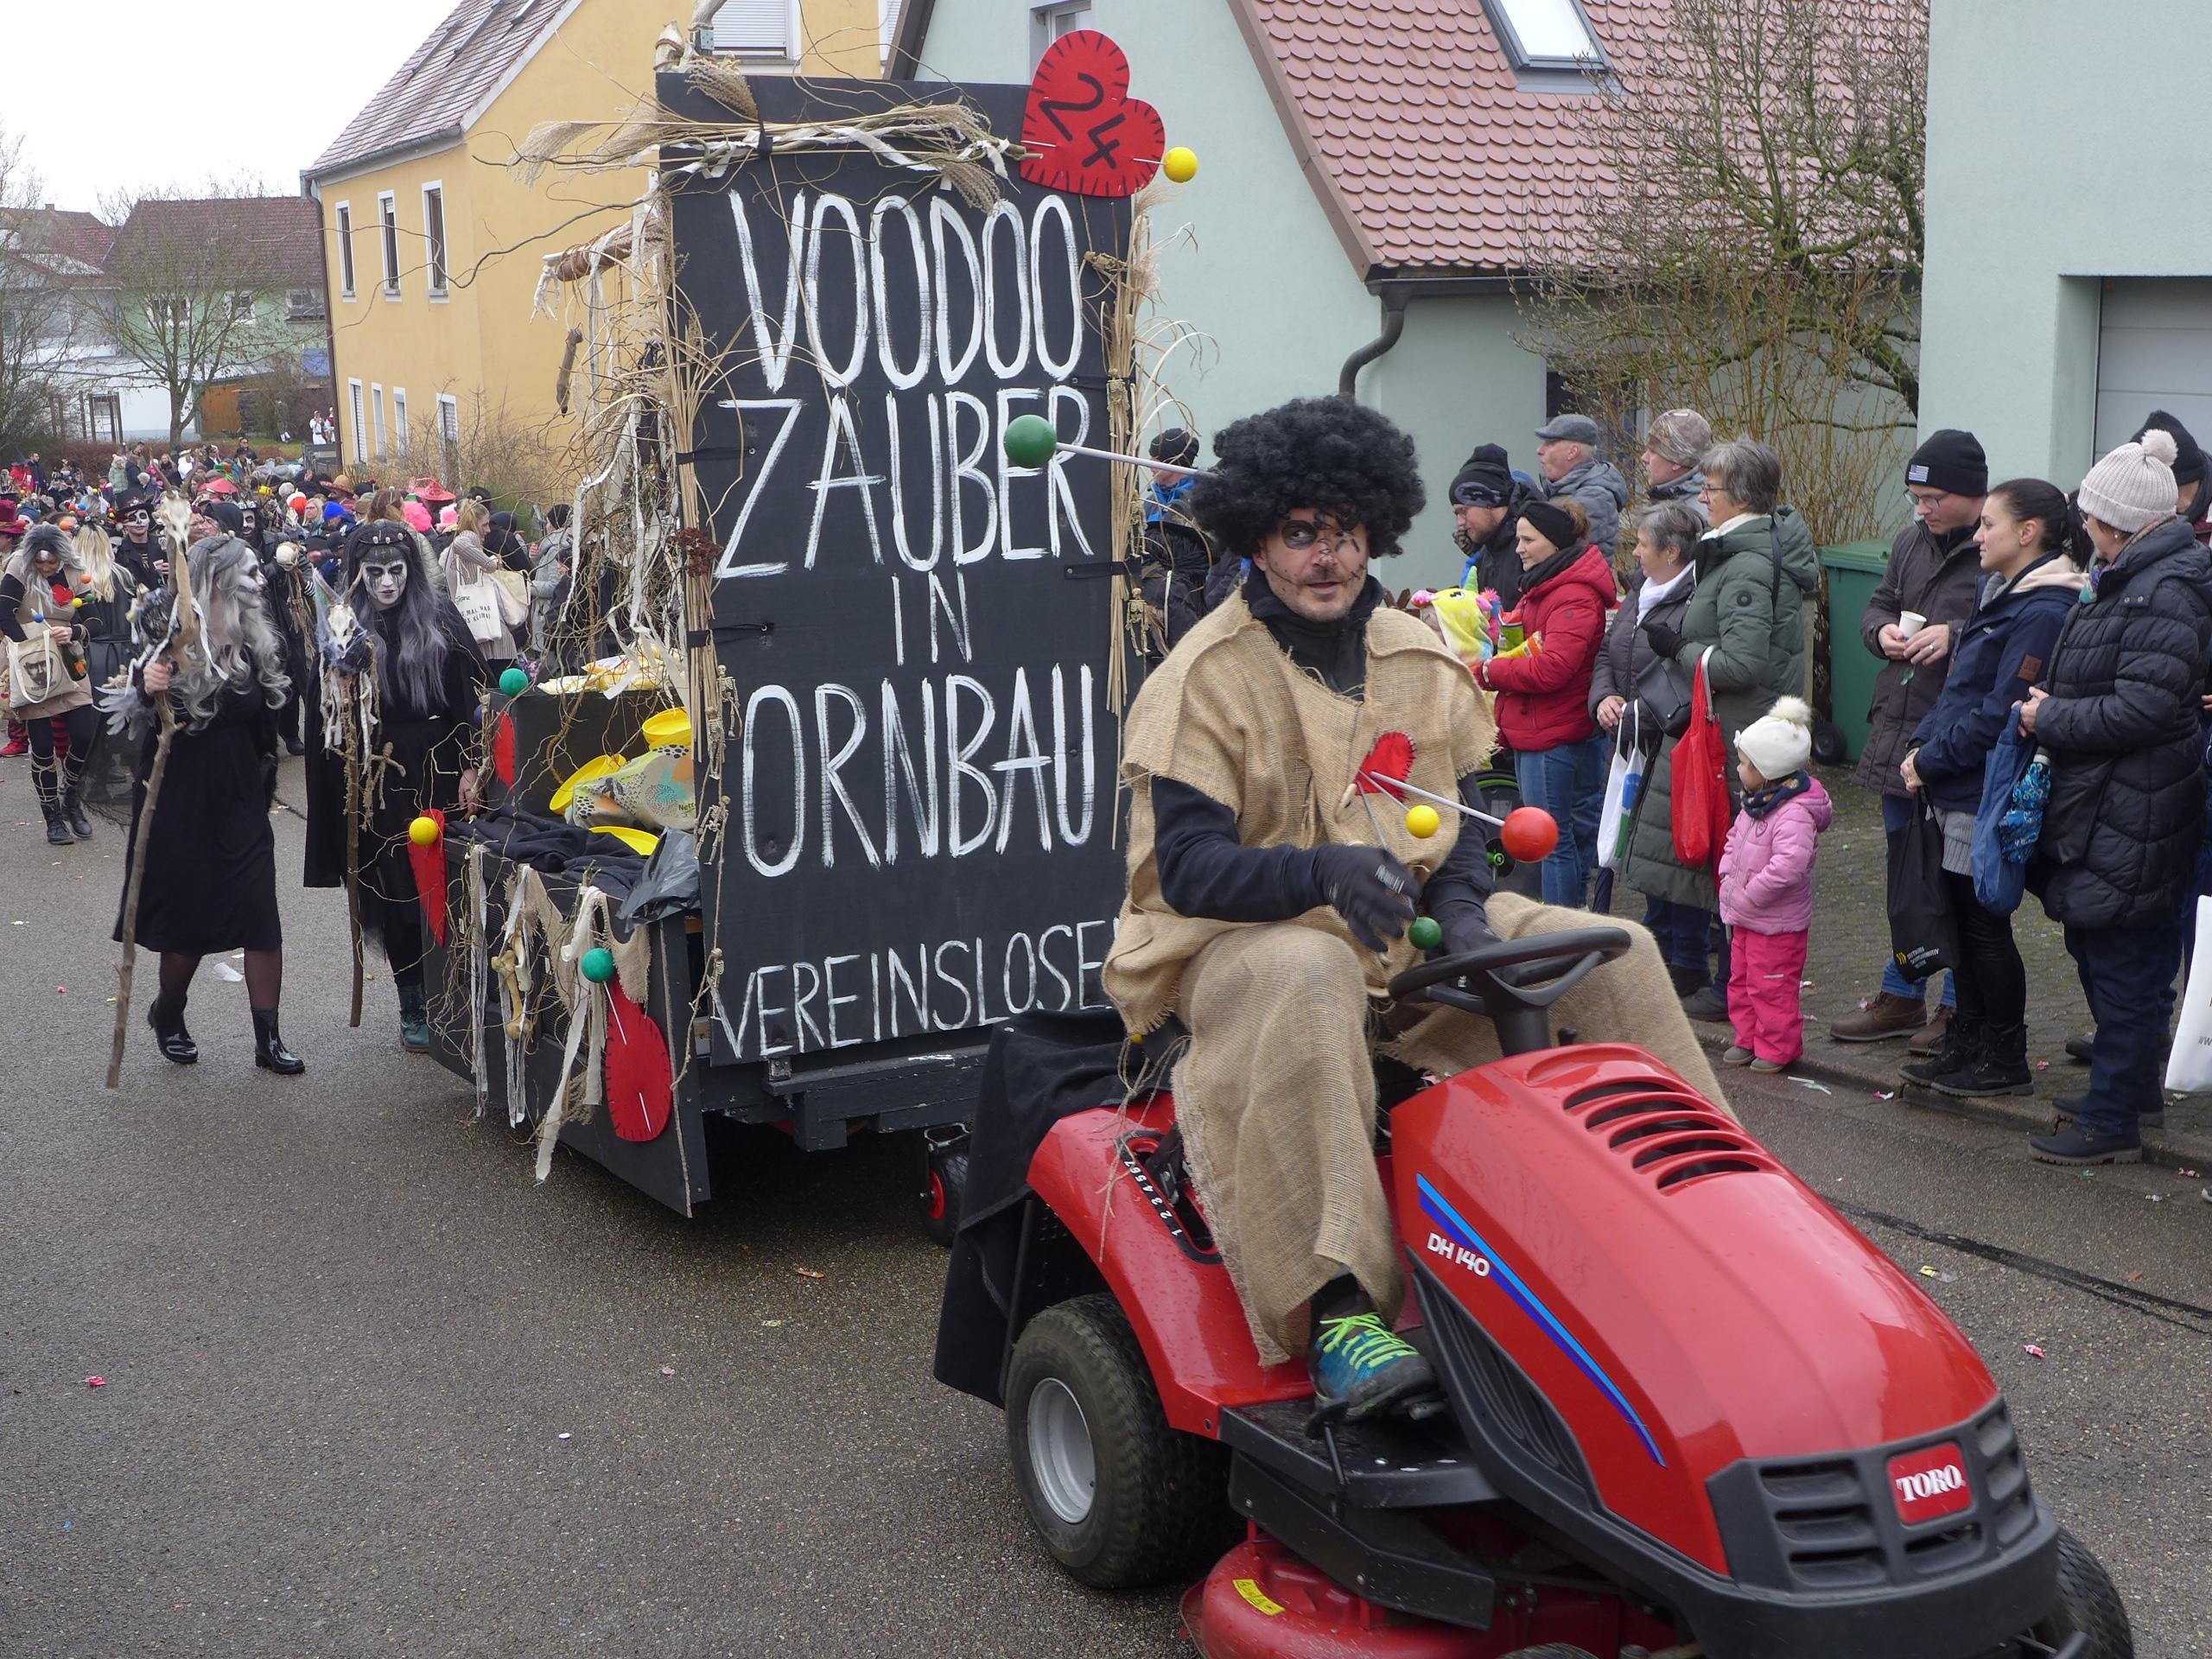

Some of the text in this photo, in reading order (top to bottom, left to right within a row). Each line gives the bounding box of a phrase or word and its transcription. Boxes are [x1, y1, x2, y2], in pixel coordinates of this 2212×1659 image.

[1038, 72, 1127, 169] 24
[728, 188, 1085, 394] VOODOO
[714, 384, 1095, 579] ZAUBER
[891, 570, 973, 667] IN
[741, 663, 1095, 877] ORNBAU
[710, 917, 1120, 1059] VEREINSLOSE
[1427, 1232, 1491, 1277] DH 140
[1895, 1464, 1963, 1503] TORO
